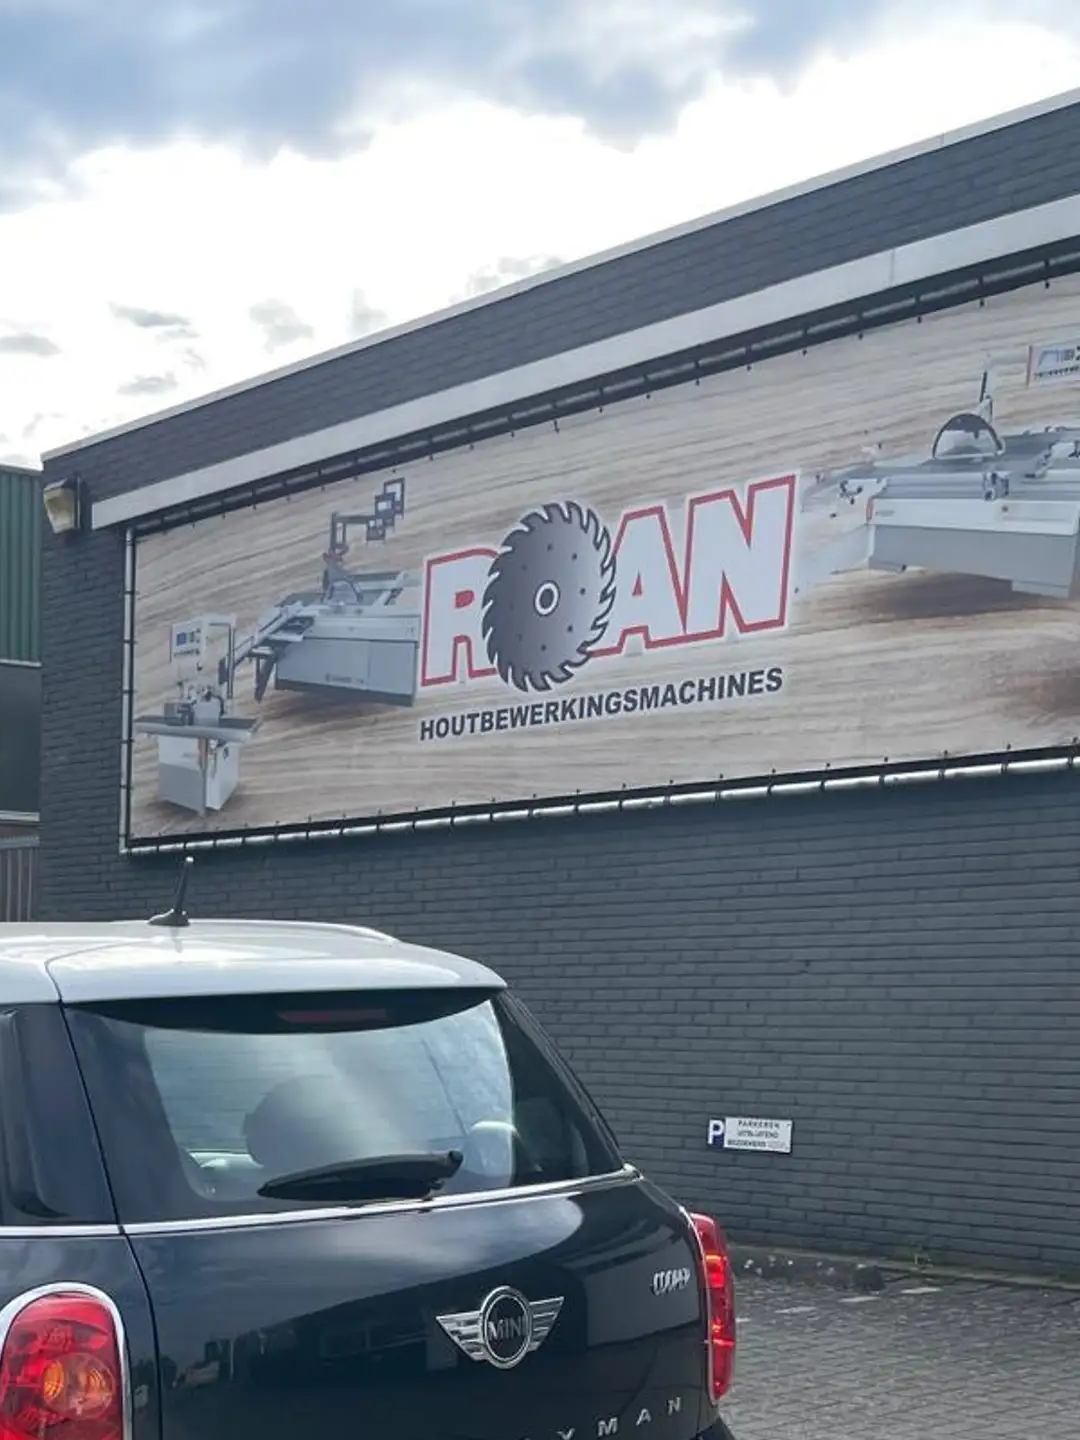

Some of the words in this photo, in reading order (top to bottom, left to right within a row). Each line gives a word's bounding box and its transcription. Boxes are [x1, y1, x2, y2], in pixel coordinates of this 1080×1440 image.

[420, 666, 783, 741] HOUTBEWERKINGSMACHINES
[708, 1120, 724, 1144] P
[738, 1119, 780, 1129] PARKEREN
[487, 1315, 529, 1341] MINI
